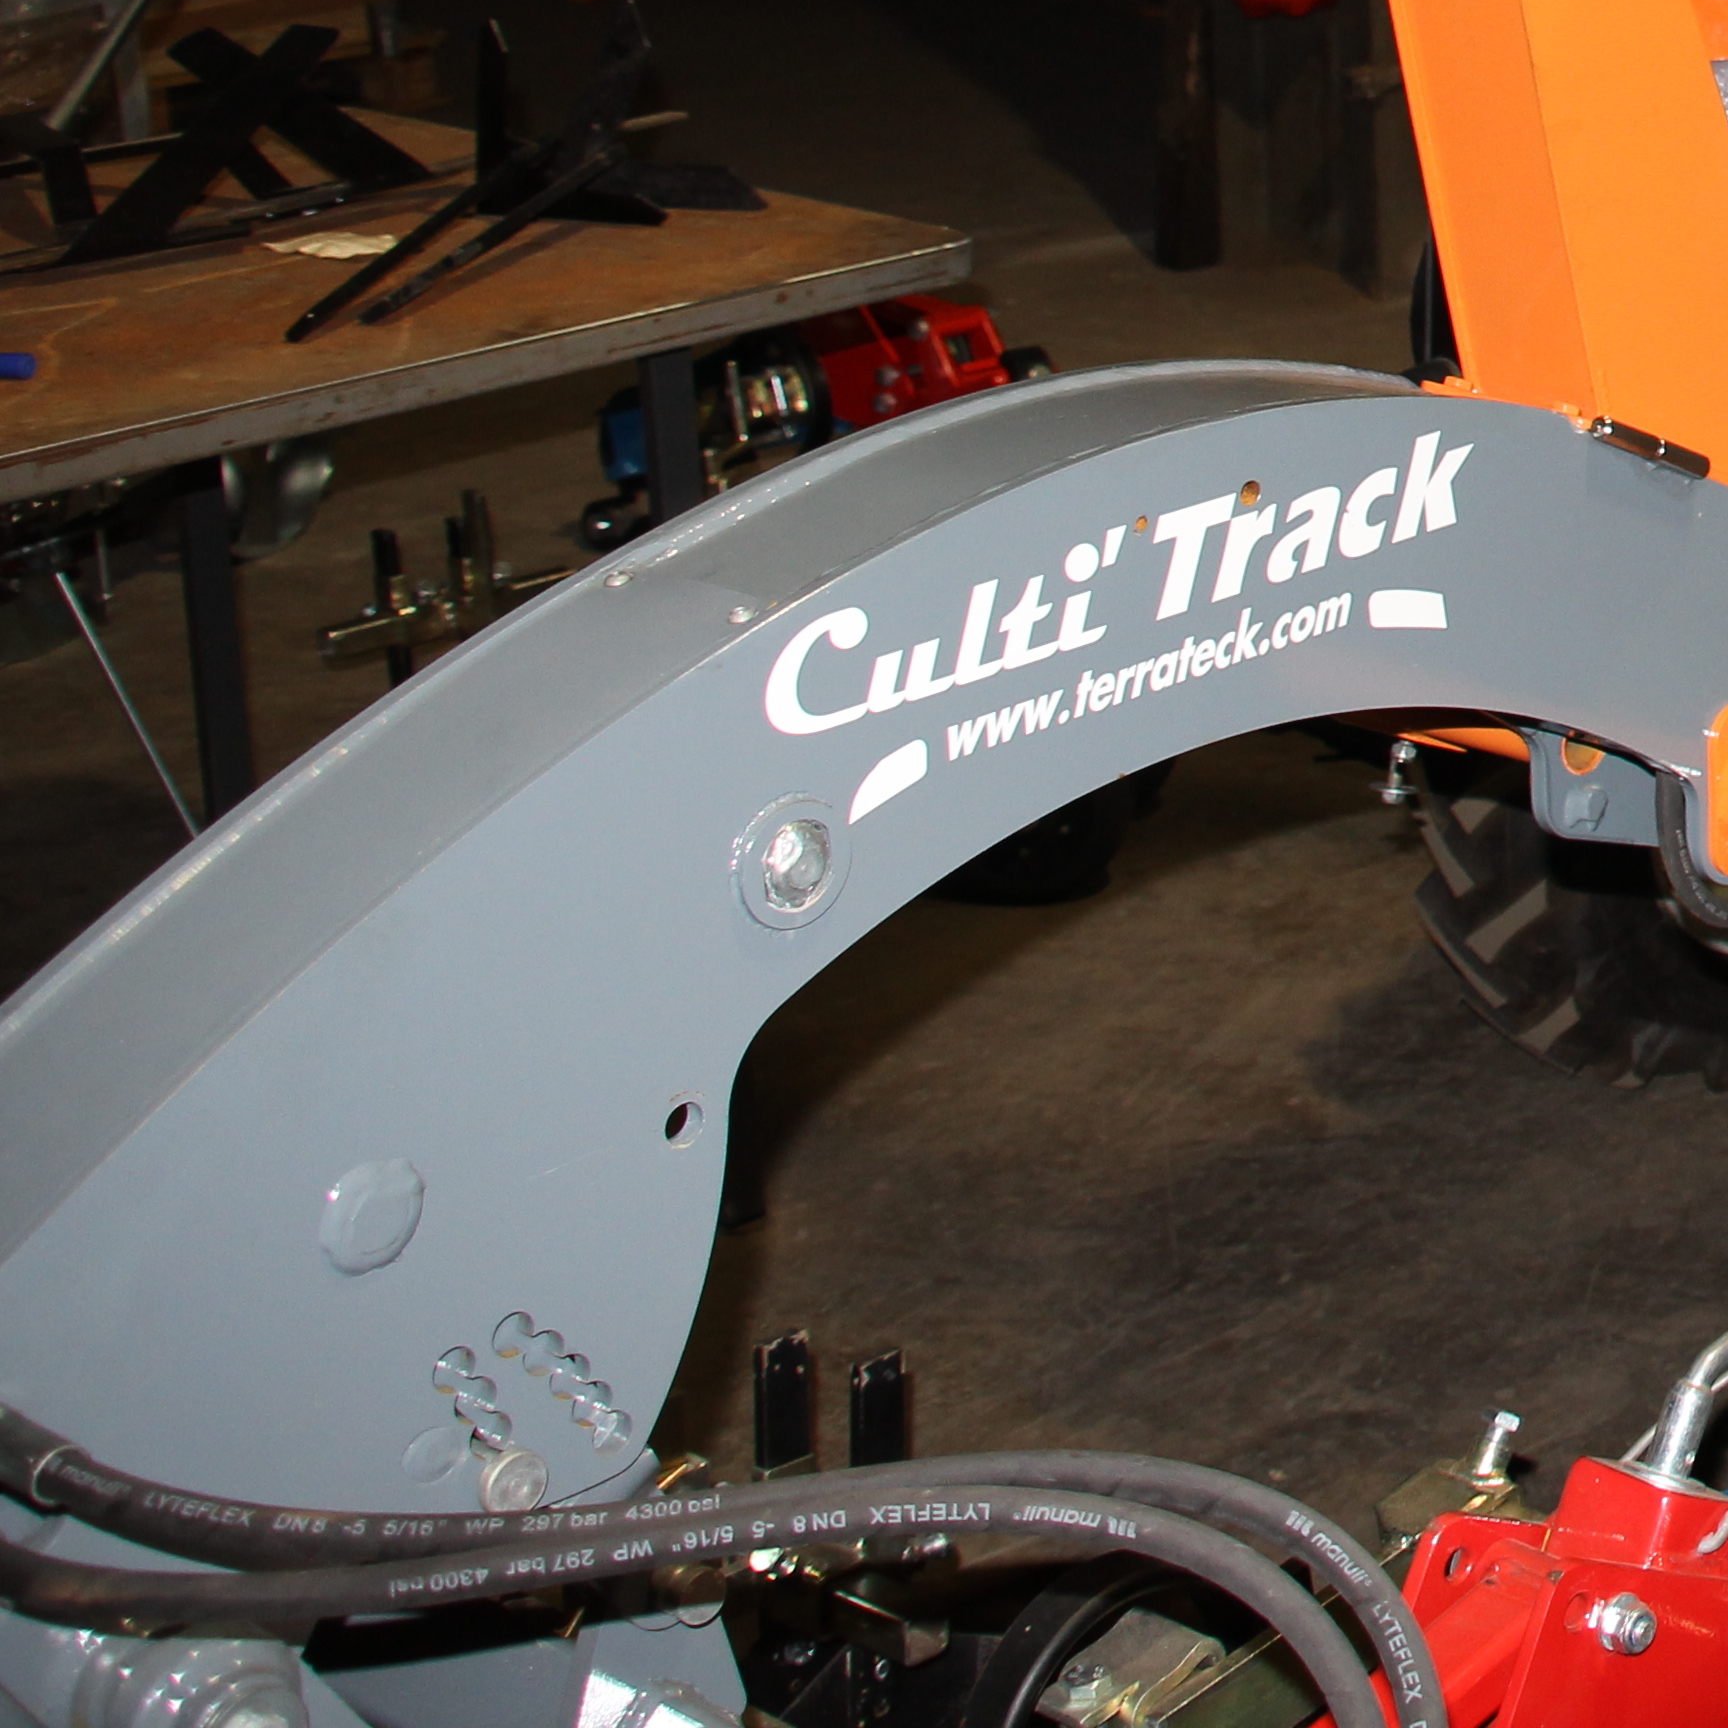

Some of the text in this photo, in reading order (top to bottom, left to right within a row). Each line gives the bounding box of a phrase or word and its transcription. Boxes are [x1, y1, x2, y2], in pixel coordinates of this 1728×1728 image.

[946, 592, 1353, 762] www.terrateck.com
[143, 1489, 257, 1527] LYTEFLEX
[464, 1519, 505, 1536] WP
[521, 1513, 562, 1533] 297
[570, 1510, 609, 1528] bar
[624, 1498, 683, 1522] 4300
[869, 1502, 991, 1525] LYTEFLEX
[612, 1539, 655, 1562] WP
[671, 1524, 735, 1553] 5/16"
[505, 1556, 547, 1576] bar
[550, 1547, 596, 1571] 297
[429, 1567, 490, 1593] 4300
[1371, 1600, 1423, 1704] LYTEFLEX
